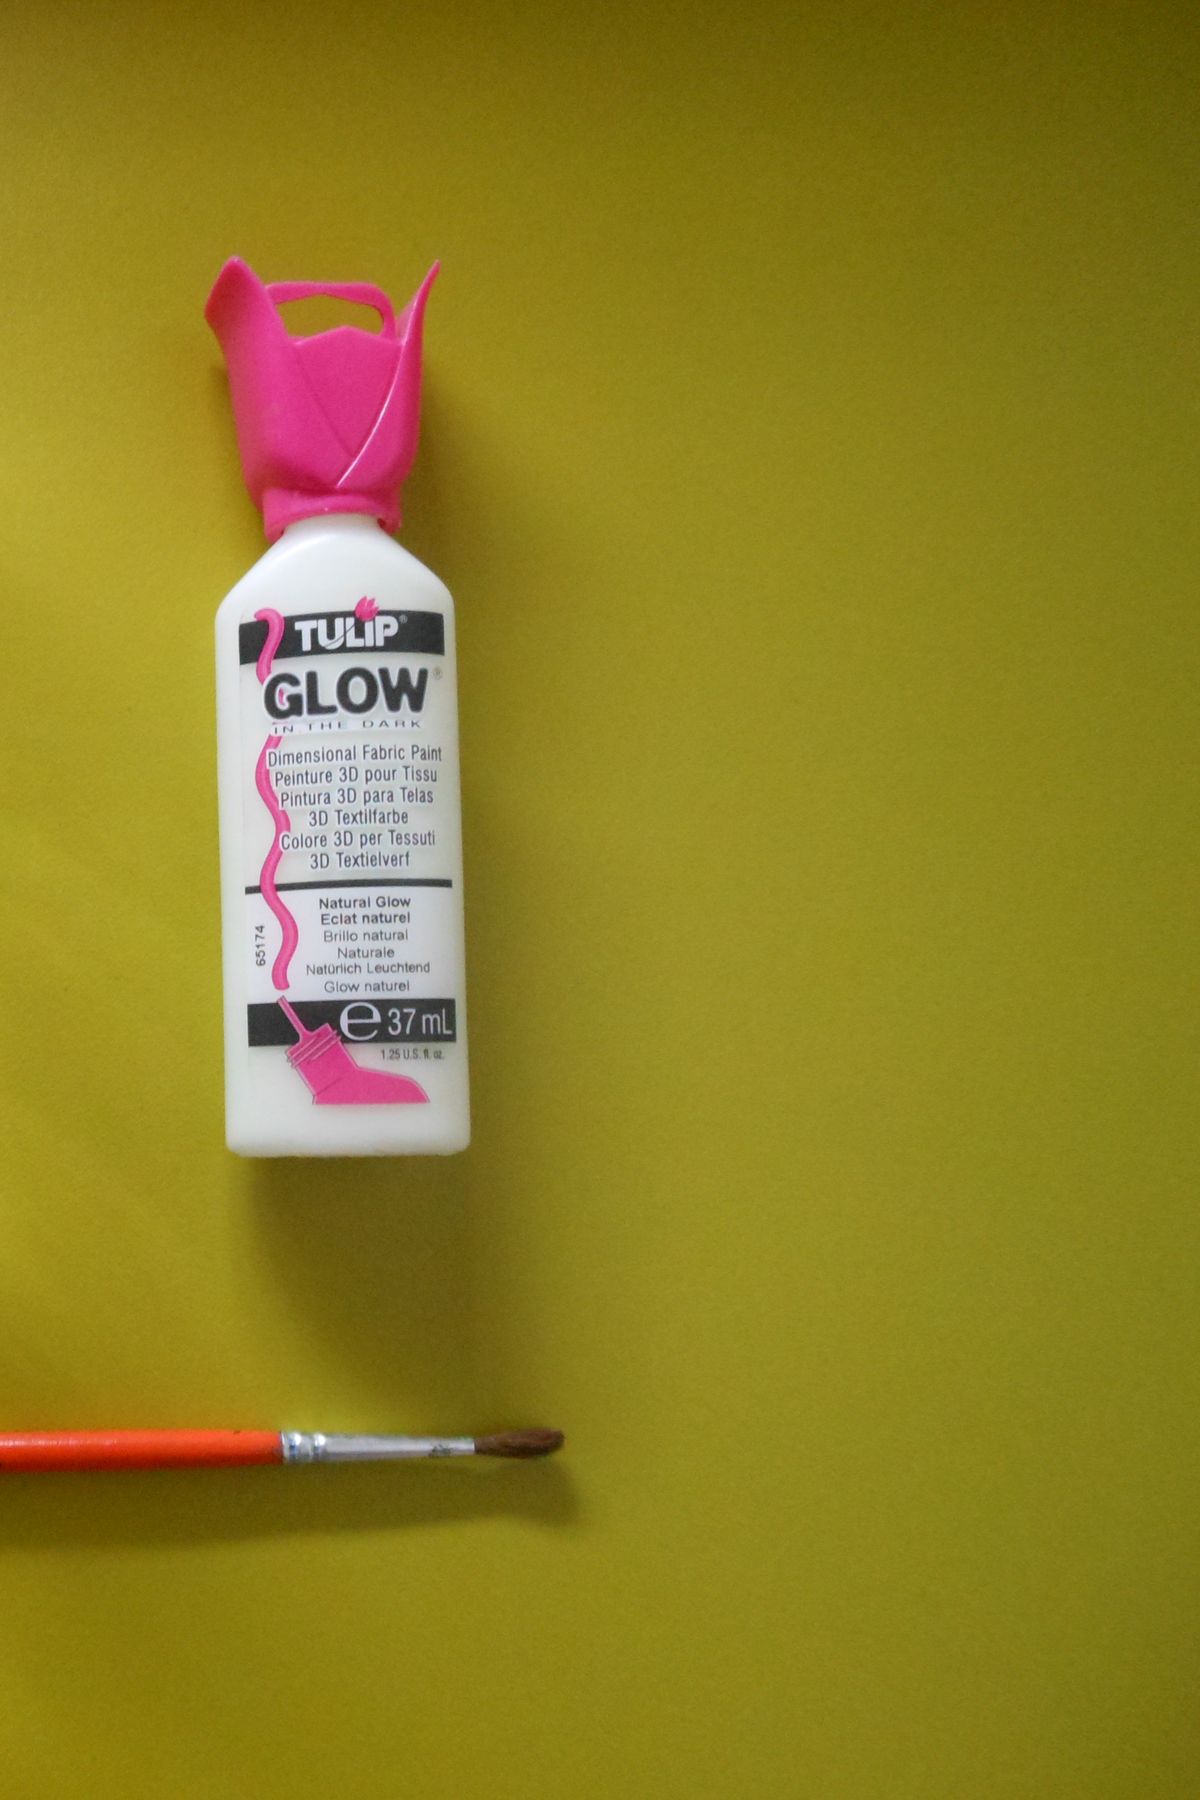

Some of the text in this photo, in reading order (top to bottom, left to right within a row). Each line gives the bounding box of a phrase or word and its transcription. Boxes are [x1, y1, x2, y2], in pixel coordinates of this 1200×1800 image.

[295, 615, 399, 651] TULIP
[264, 667, 429, 720] GLOW
[274, 719, 422, 735] IN THE DARK
[268, 744, 442, 767] Dimensional Fabric Paint
[275, 766, 438, 787] Peinture 3D pour Tissu
[280, 788, 434, 808] Pintura 3D para Telas
[309, 808, 409, 827] 3D Textilfarbe
[281, 829, 436, 850] Colore 3D per Tessuti
[310, 851, 410, 869] 3D Textielverf
[319, 896, 411, 909] Natural Glow
[321, 912, 411, 925] Eclat naturel
[323, 928, 409, 942] Brillo natural
[255, 925, 266, 967] 65174
[337, 946, 395, 959] Naturale
[306, 962, 431, 975] Natürlich Leuchtend
[324, 979, 410, 993] Glow naturel
[387, 1007, 417, 1036] 37
[421, 1007, 453, 1035] mL
[381, 1048, 401, 1060] 1.25
